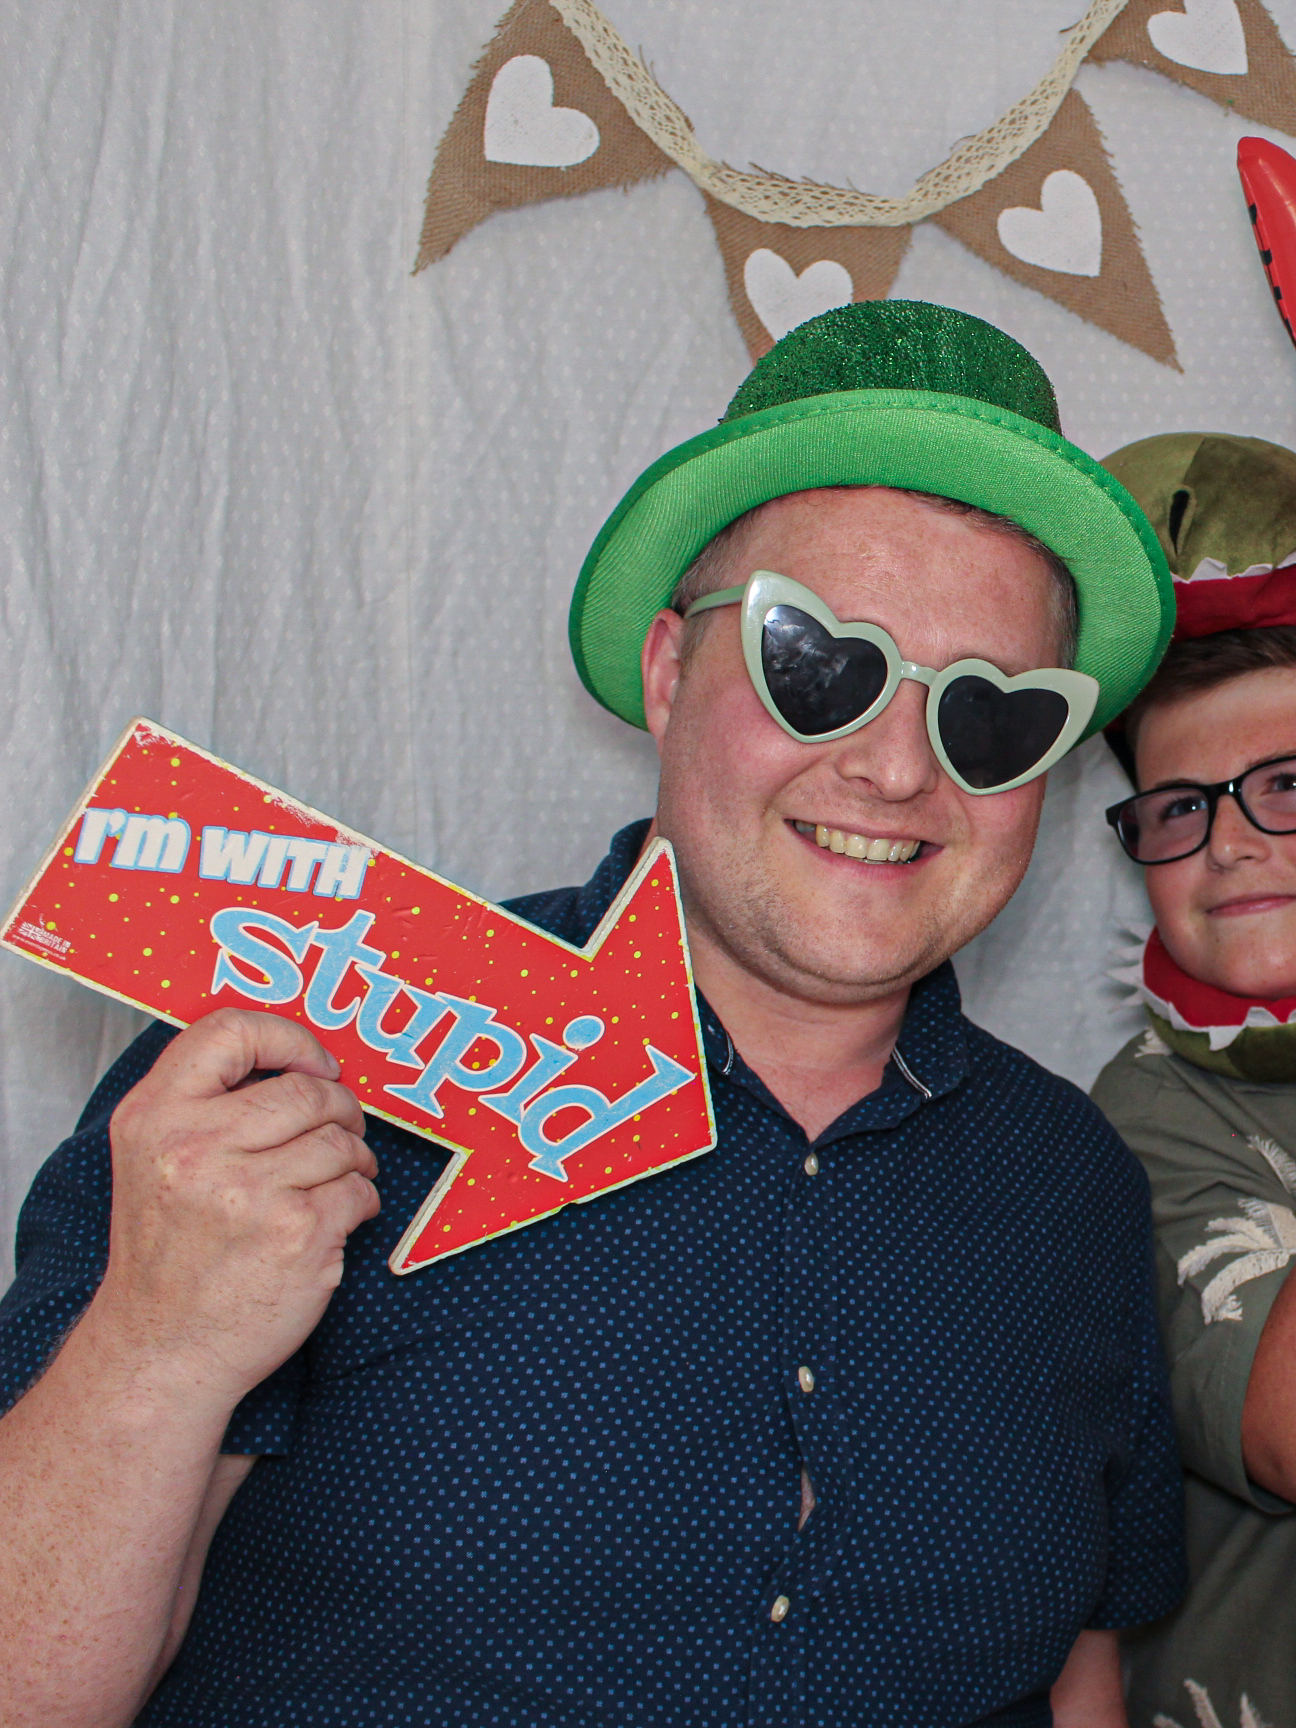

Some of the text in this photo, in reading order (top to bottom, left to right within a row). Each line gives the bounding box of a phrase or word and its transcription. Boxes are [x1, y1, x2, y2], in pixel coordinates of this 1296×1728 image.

[199, 825, 371, 899] WITH
[39, 937, 68, 953] BRITAIN
[42, 929, 63, 944] MADE
[62, 940, 72, 948] IN
